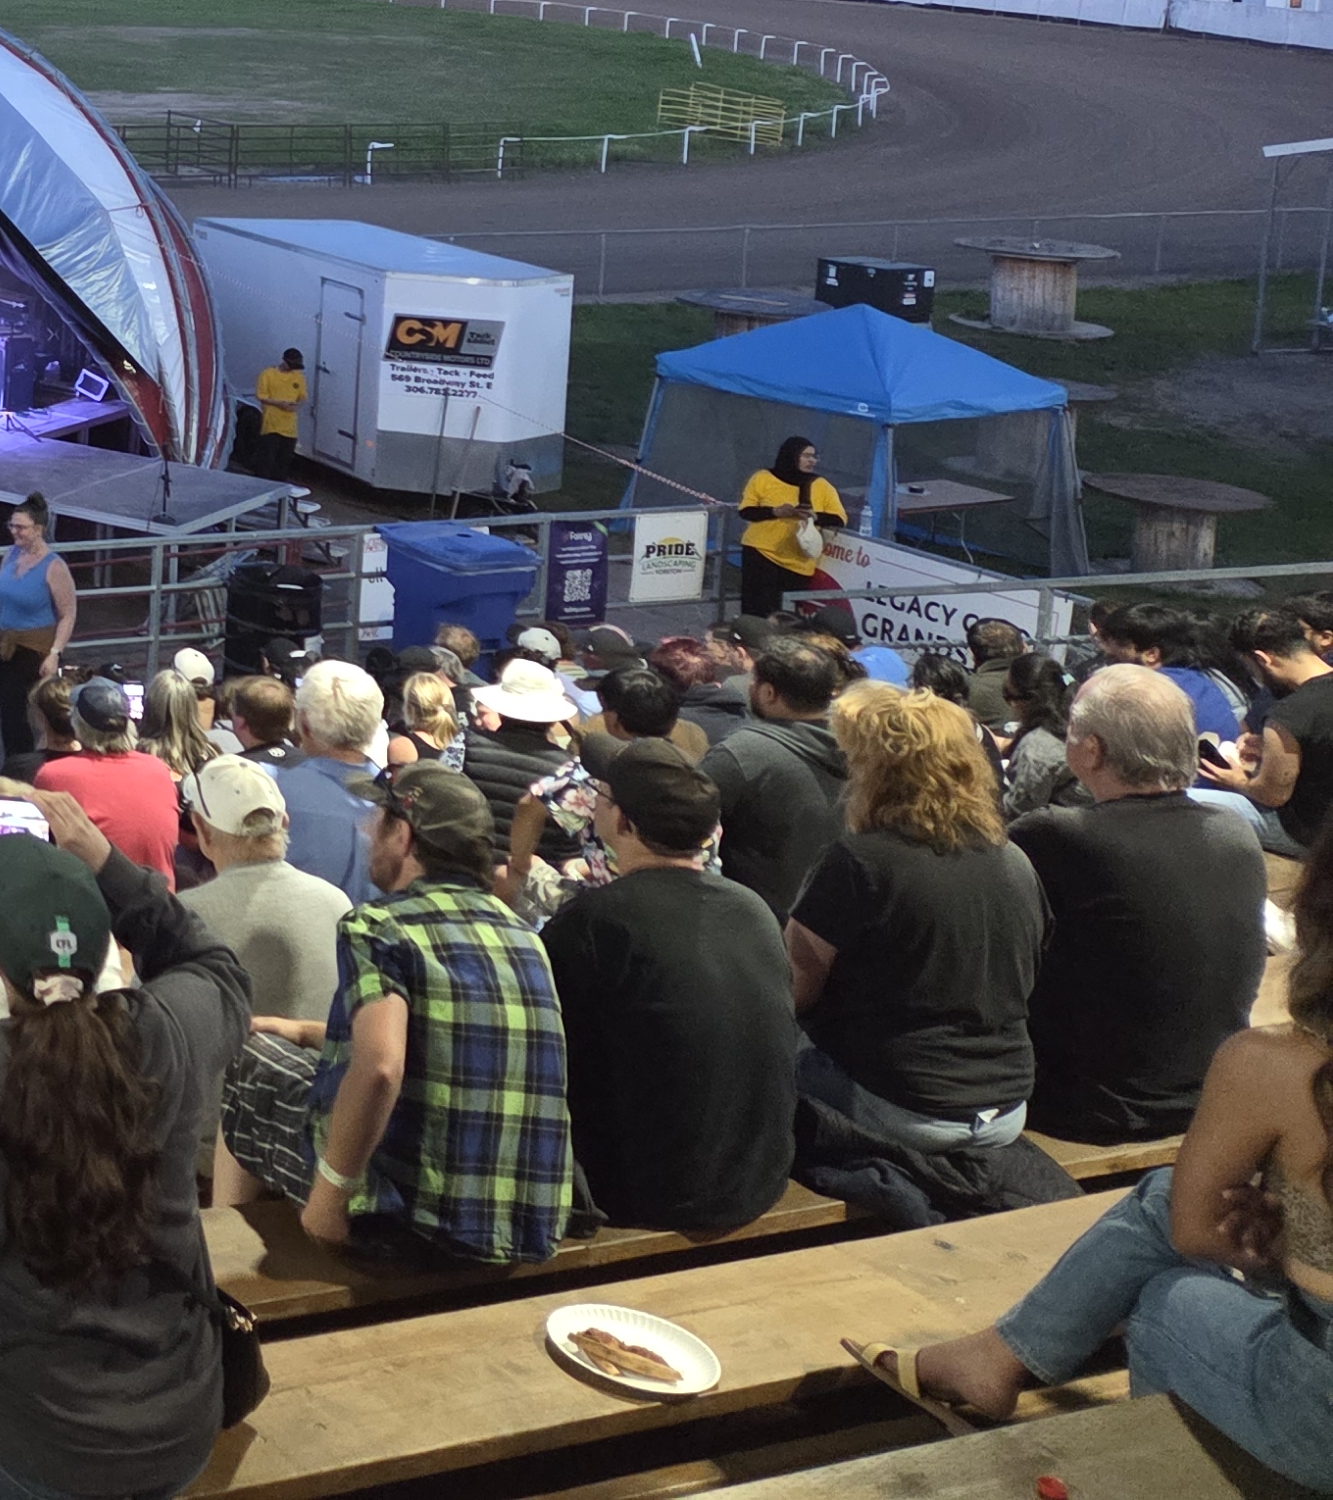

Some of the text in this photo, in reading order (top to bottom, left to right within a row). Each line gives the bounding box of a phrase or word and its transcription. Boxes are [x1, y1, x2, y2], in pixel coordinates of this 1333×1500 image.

[476, 357, 491, 365] LTD
[390, 363, 495, 380] Trailers Tack Feed
[414, 375, 467, 389] Broadway
[645, 542, 696, 559] PRIDE
[856, 545, 871, 567] to
[641, 559, 697, 571] LANDSCAPING
[862, 581, 958, 627] LEGACY
